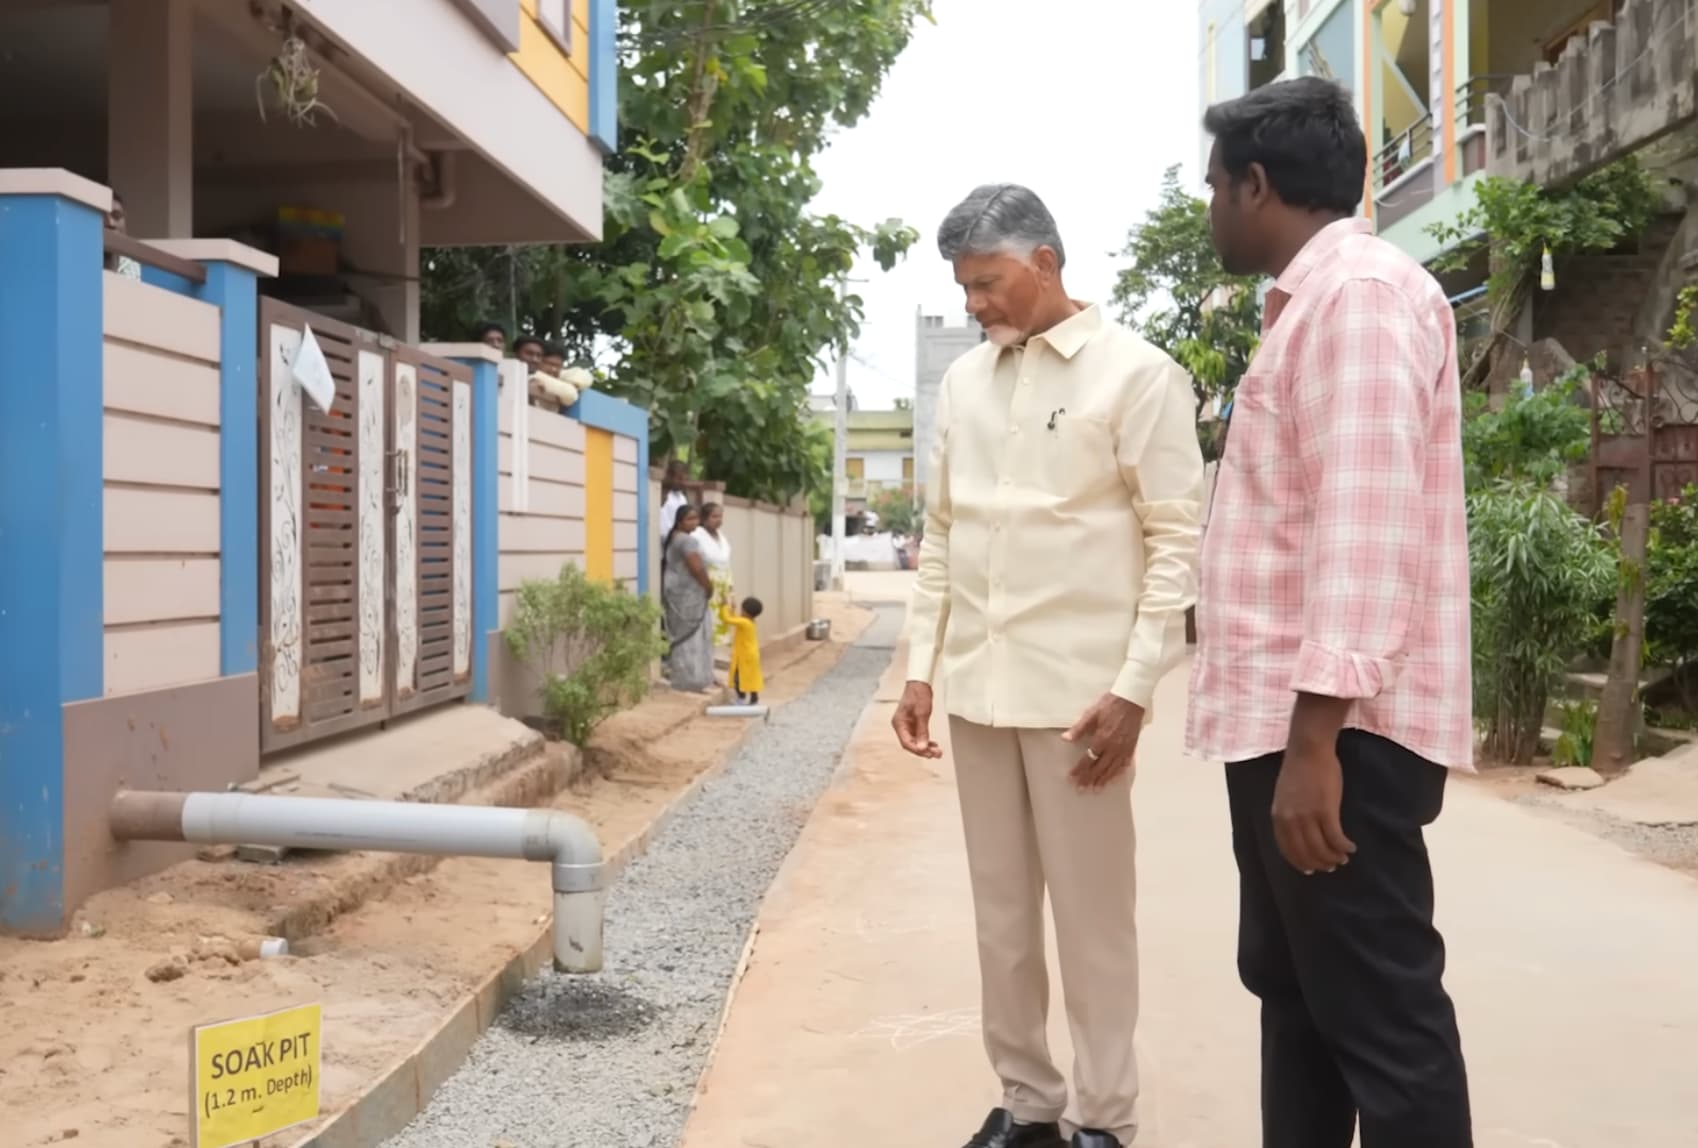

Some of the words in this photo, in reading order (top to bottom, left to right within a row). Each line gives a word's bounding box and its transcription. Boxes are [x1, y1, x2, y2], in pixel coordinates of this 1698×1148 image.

[211, 1041, 275, 1080] SOAK
[279, 1032, 311, 1062] PIT
[204, 1088, 236, 1119] (1.2
[240, 1087, 262, 1102] m.
[266, 1064, 312, 1096] Depth)
